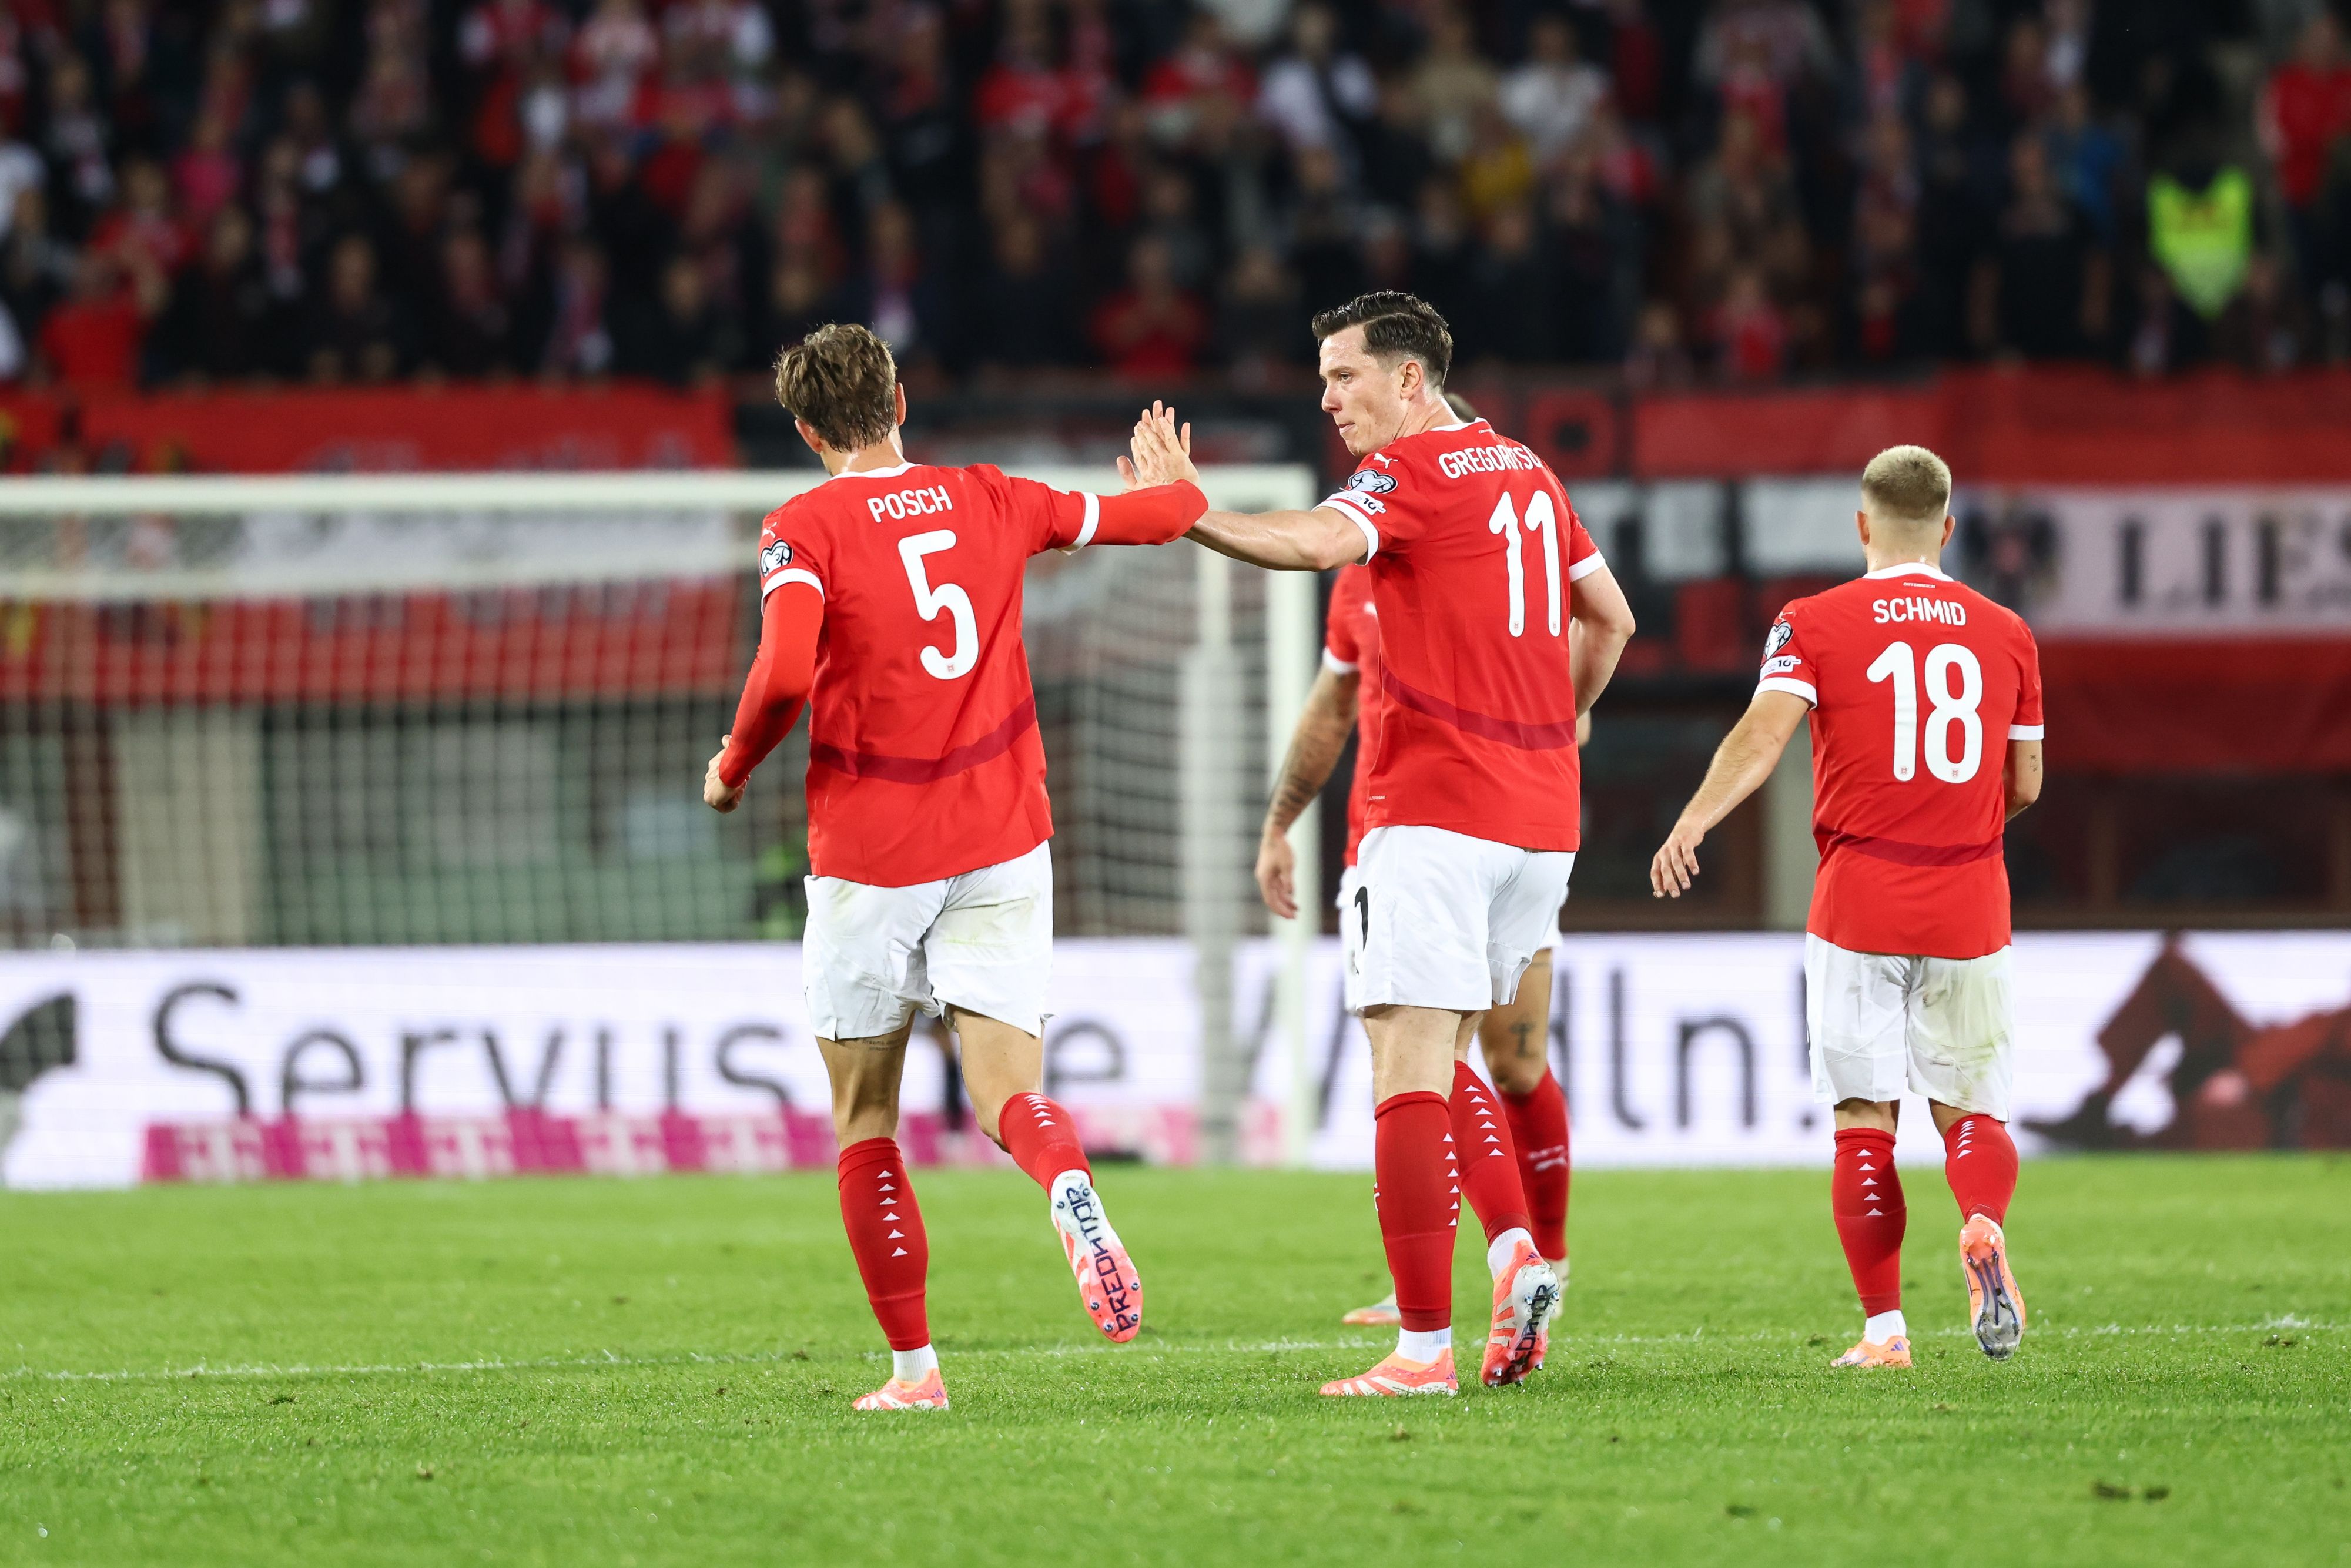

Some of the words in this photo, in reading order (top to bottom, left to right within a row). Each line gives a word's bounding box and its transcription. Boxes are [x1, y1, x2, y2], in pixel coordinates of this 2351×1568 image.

[866, 485, 953, 523] POSCH
[1488, 490, 1561, 638] 11
[897, 529, 979, 680] 5
[1872, 597, 1967, 626] SCHMID
[1866, 641, 1983, 783] 18
[154, 980, 795, 1120] Servus
